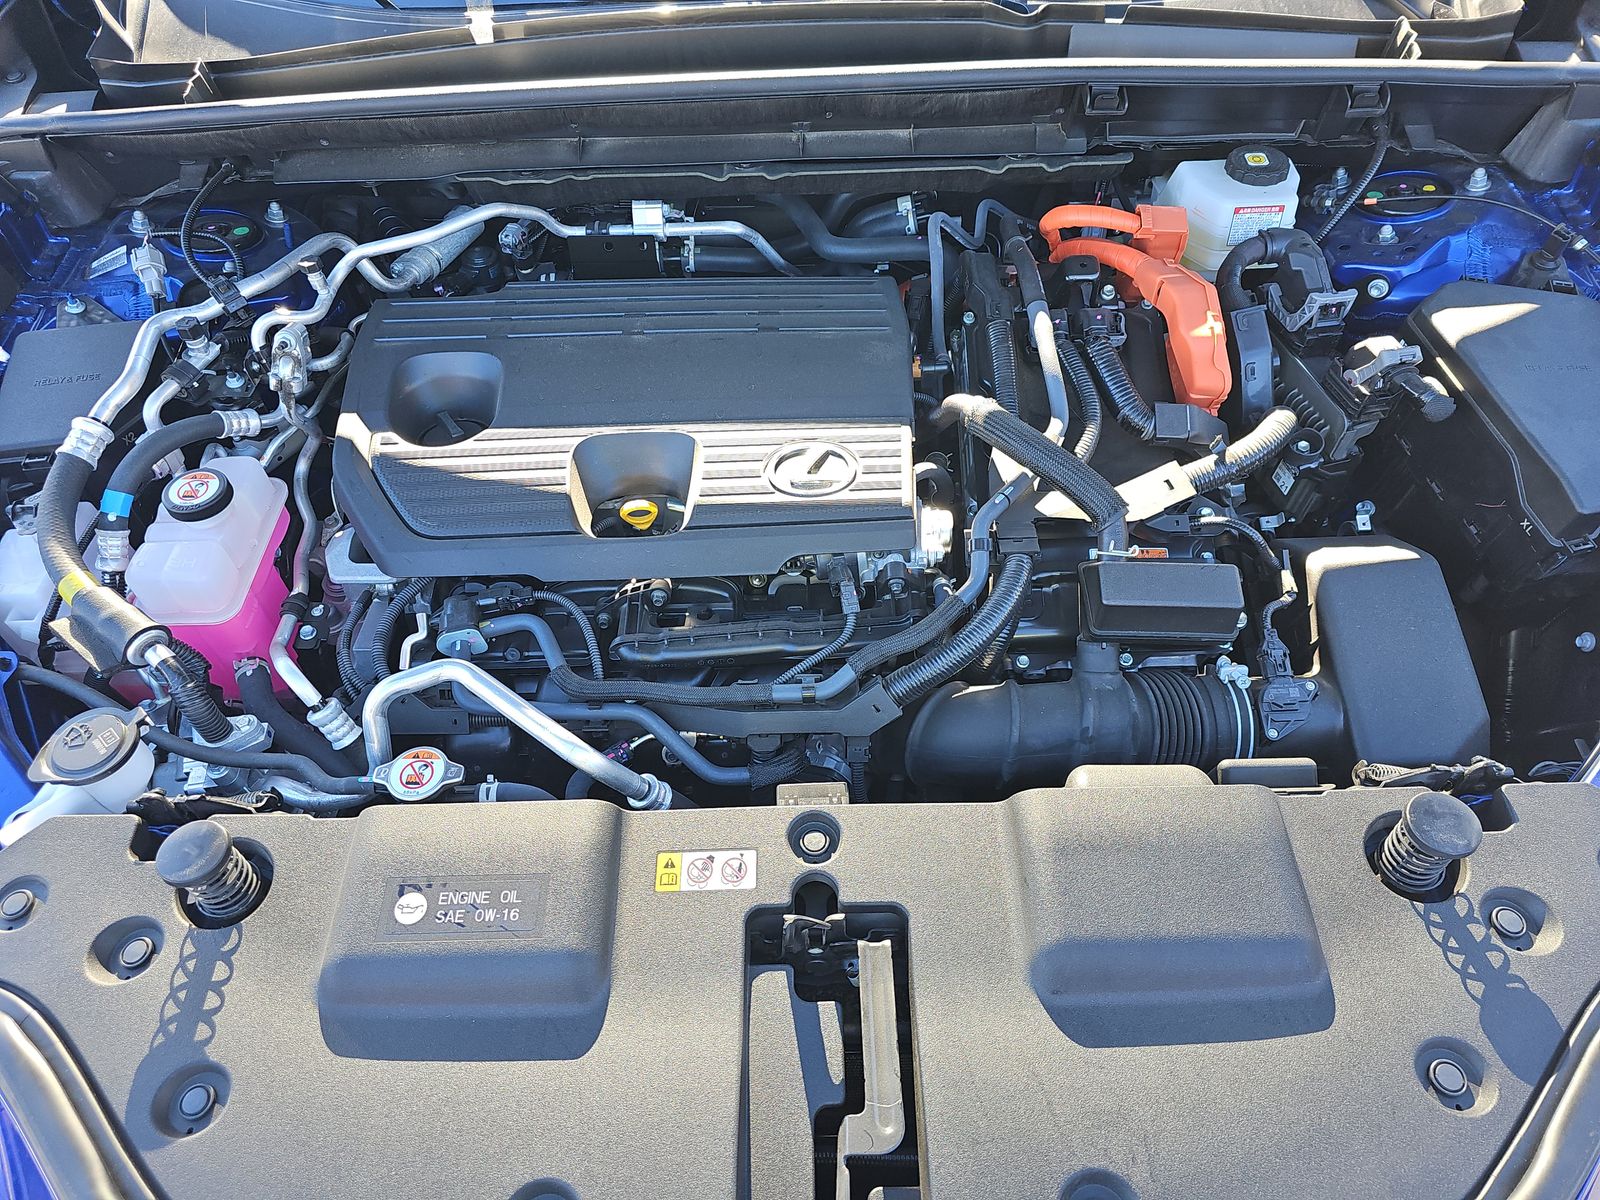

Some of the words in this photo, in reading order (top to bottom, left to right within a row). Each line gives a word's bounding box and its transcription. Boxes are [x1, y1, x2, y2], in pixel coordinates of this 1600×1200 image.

[76, 373, 101, 383] FUSE
[1519, 518, 1533, 537] XL
[438, 891, 492, 905] ENGINE
[500, 890, 522, 903] OIL
[435, 909, 466, 924] SAE
[474, 908, 520, 922] 0W-16
